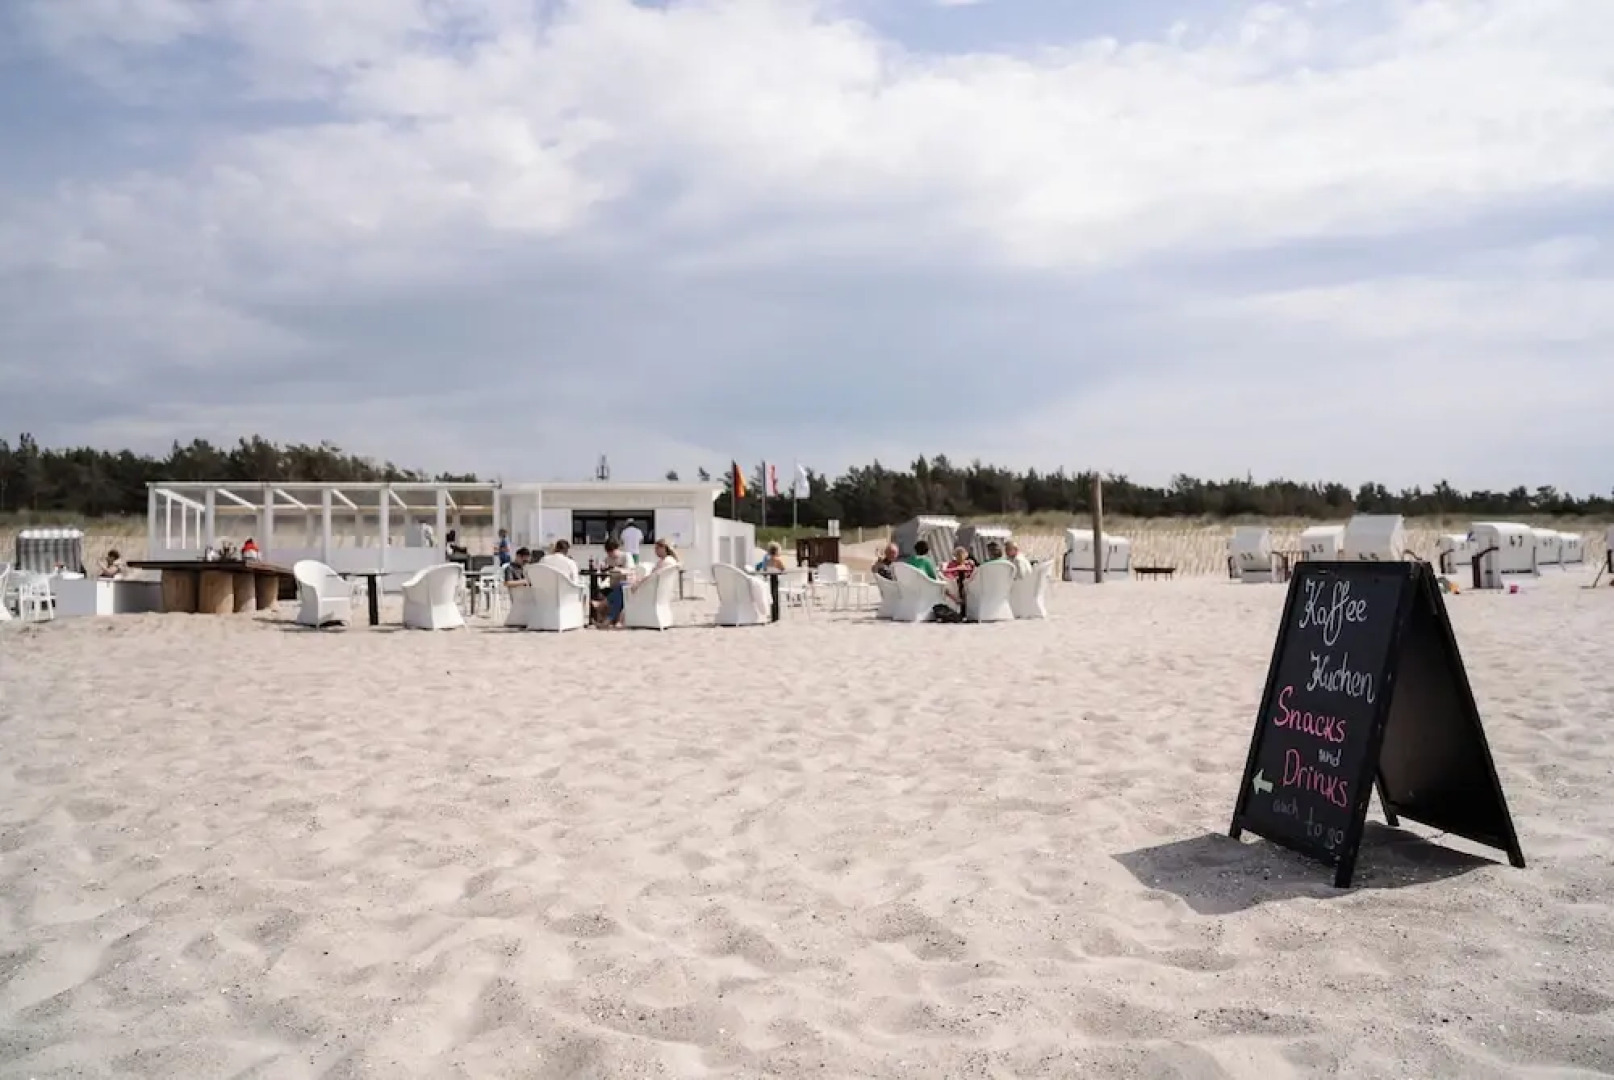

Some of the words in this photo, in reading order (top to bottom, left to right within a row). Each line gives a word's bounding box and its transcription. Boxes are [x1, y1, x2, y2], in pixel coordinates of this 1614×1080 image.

[1299, 577, 1368, 647] Kaffee
[1306, 650, 1376, 704] Kuchen
[1273, 685, 1347, 743] Snacks
[1282, 748, 1349, 808] Drinks
[1318, 748, 1342, 767] und
[1272, 797, 1300, 820] auch
[1304, 806, 1323, 837] to
[1324, 827, 1345, 850] go
